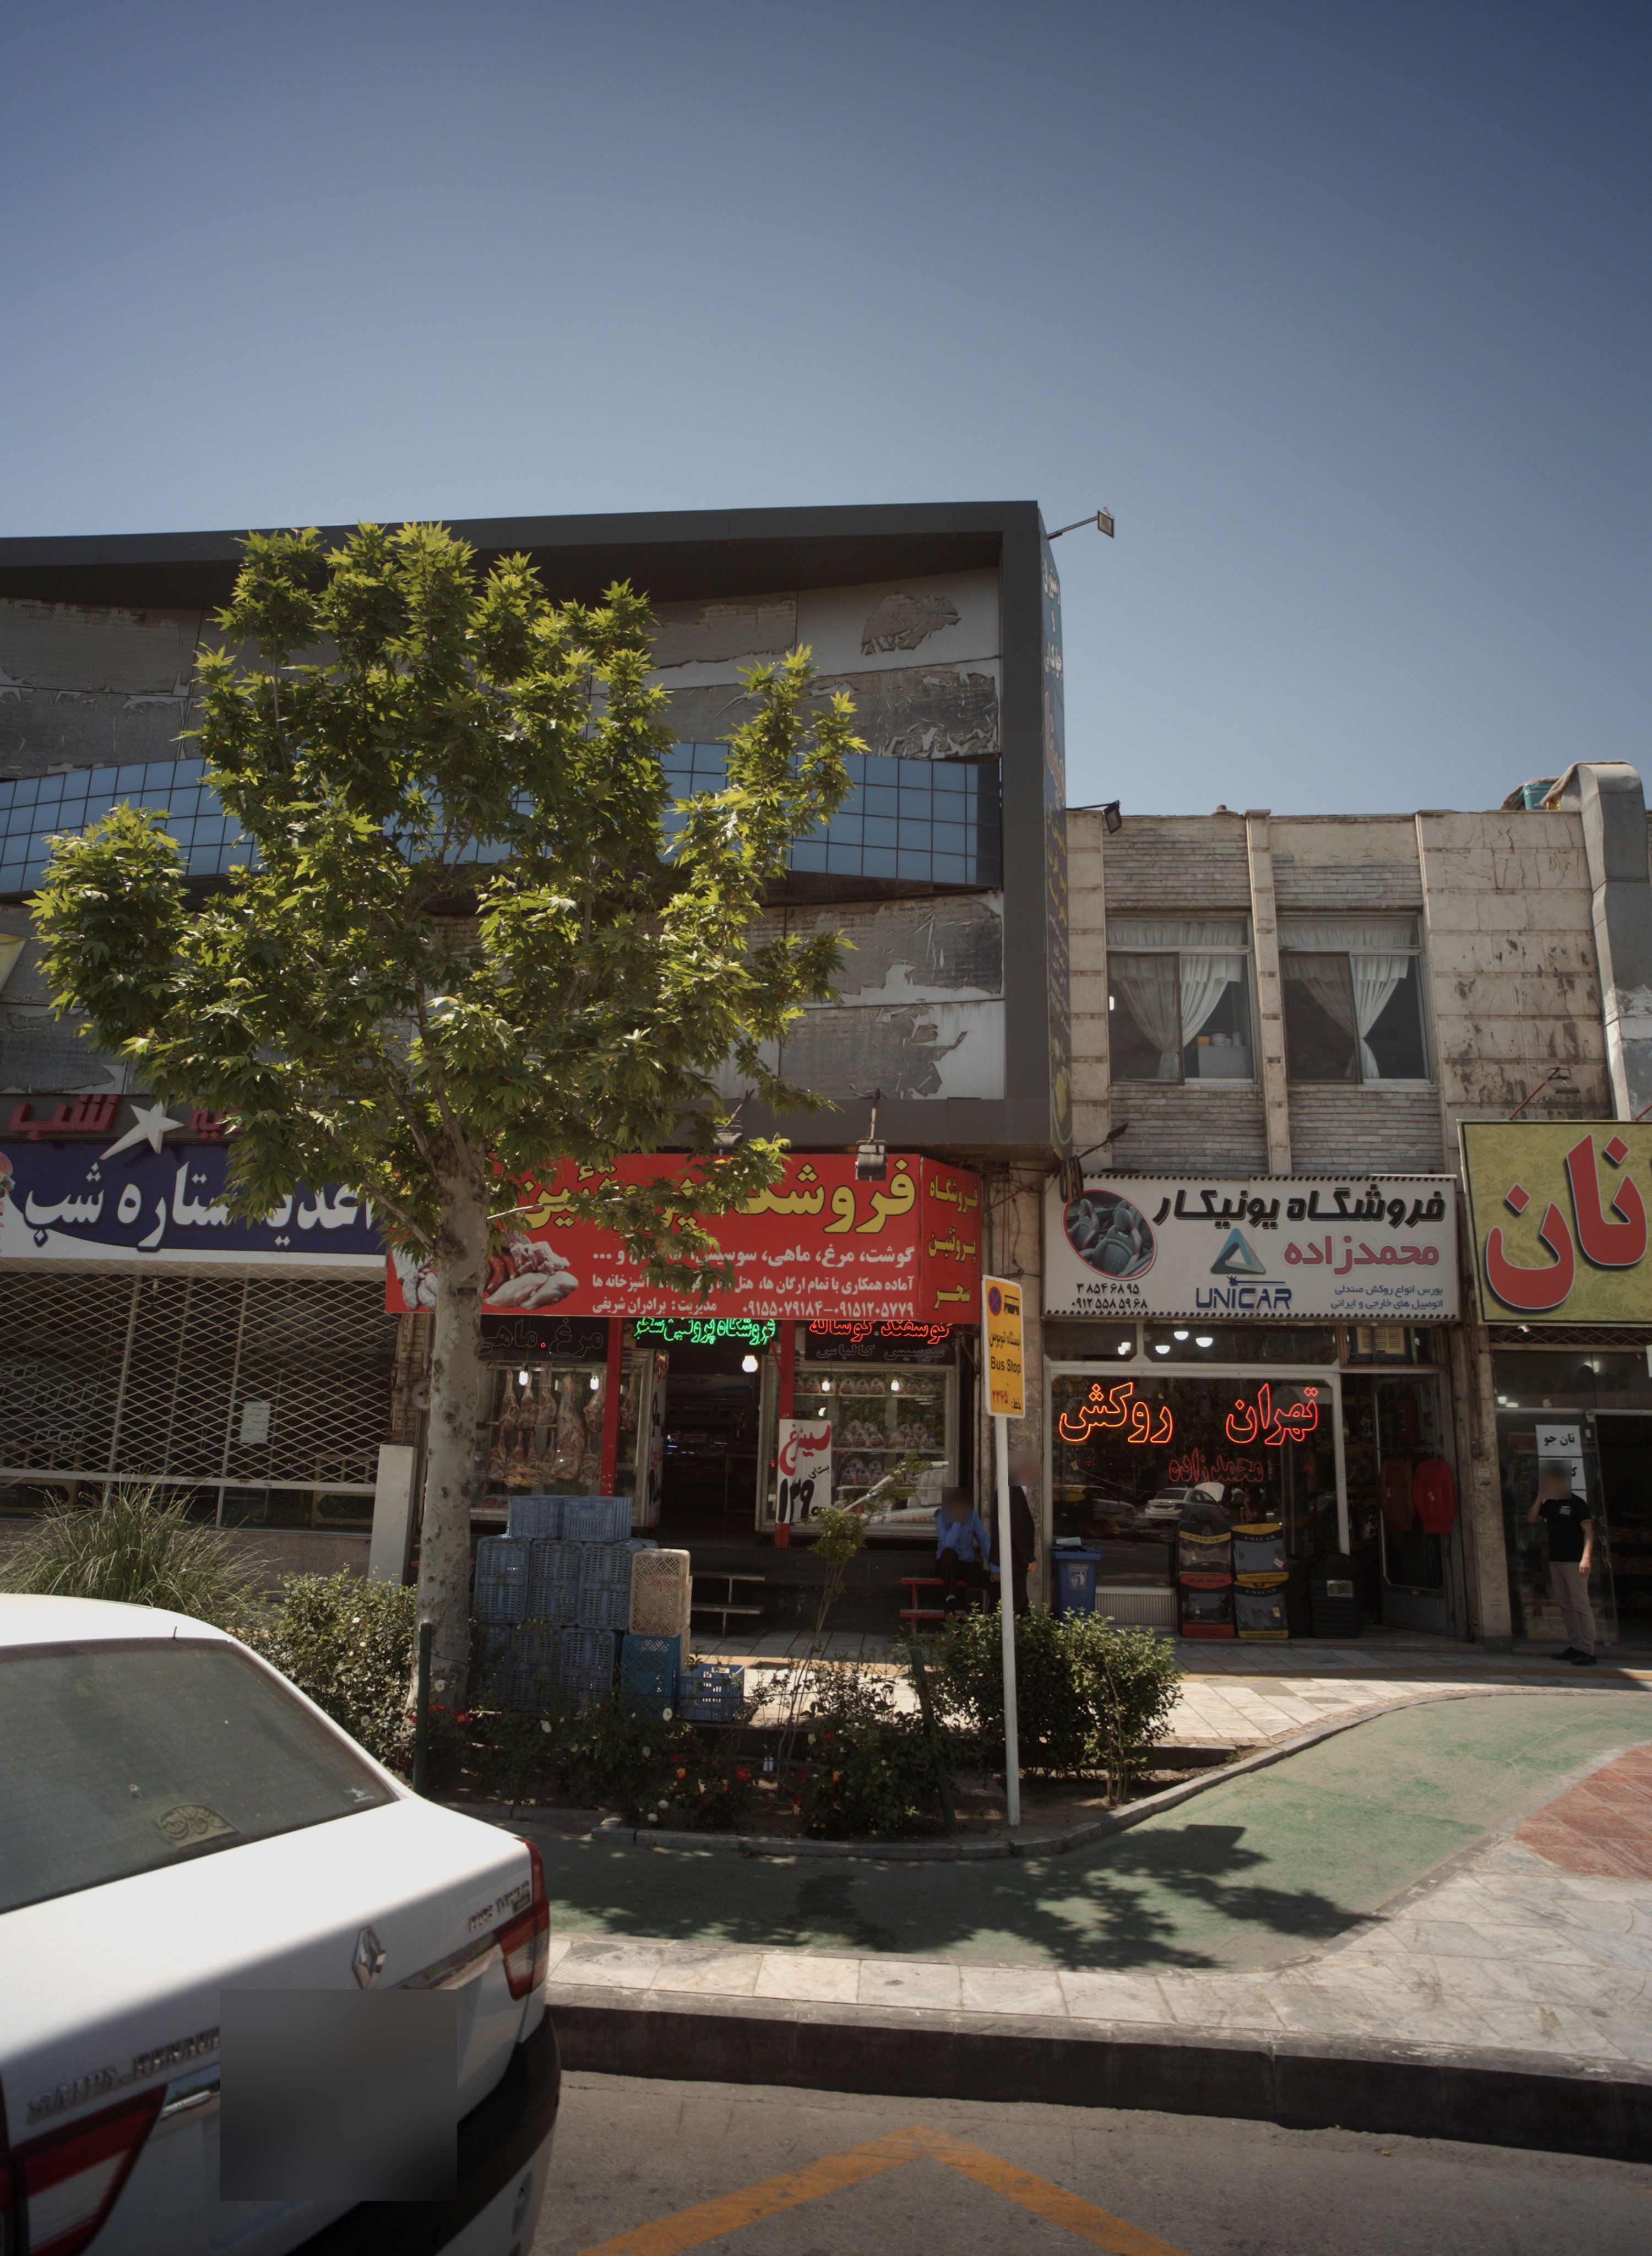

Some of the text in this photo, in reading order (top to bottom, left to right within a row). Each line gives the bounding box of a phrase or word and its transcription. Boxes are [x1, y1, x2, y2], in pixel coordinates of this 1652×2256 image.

[8, 1094, 122, 1140] شب
[25, 1162, 105, 1243] شب
[929, 1173, 979, 1213] فروشگاه
[117, 1161, 233, 1247] ستاره
[1152, 1184, 1445, 1229] فروشگاه یونیکار
[1486, 1134, 1647, 1309] نان
[928, 1225, 977, 1265] پروتئین
[1285, 1235, 1439, 1275] محمدزاده
[616, 1250, 625, 1265] و
[593, 1274, 603, 1288] ها
[735, 1276, 754, 1293] هتل
[776, 1276, 806, 1294] ارگان
[808, 1277, 830, 1294] تمام
[831, 1276, 839, 1294] با
[841, 1277, 882, 1295] همکاری
[885, 1275, 915, 1291] آماده
[1334, 1284, 1443, 1298] بورس انواع روکش صندلی
[592, 1297, 626, 1314] شریفی
[933, 1282, 971, 1309] سحر
[1195, 1288, 1292, 1310] UNICAR
[1330, 1298, 1443, 1310] اتومبیل های خارجی و ایرانی
[627, 1297, 666, 1315] برادران
[549, 1317, 604, 1359] مرغ
[989, 1330, 1021, 1351] ایستگاه اتوبوس
[991, 1356, 1021, 1376] Bus Stop
[1059, 1382, 1319, 1445] تهران روکش
[1544, 1433, 1574, 1446] نان جو
